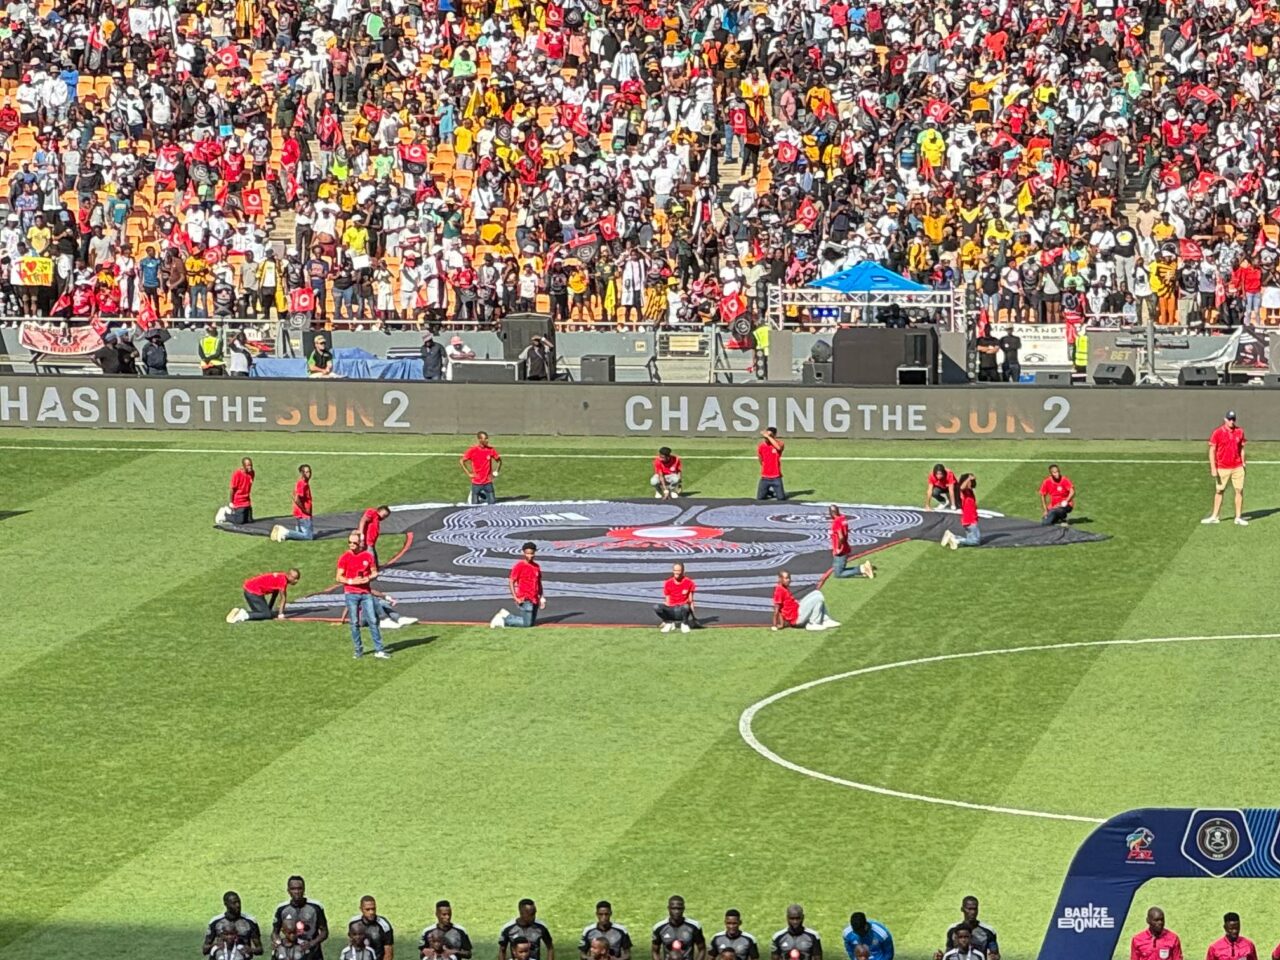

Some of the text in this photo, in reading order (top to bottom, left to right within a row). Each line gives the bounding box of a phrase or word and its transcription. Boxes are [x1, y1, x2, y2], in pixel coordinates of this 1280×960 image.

[0, 386, 190, 425] HASING
[197, 395, 267, 424] THE
[383, 390, 411, 428] 2
[624, 394, 851, 433] CHASING
[857, 404, 927, 432] THE
[1043, 396, 1071, 434] 2
[1064, 902, 1109, 918] BABIZE
[1058, 917, 1115, 933] BONKE
